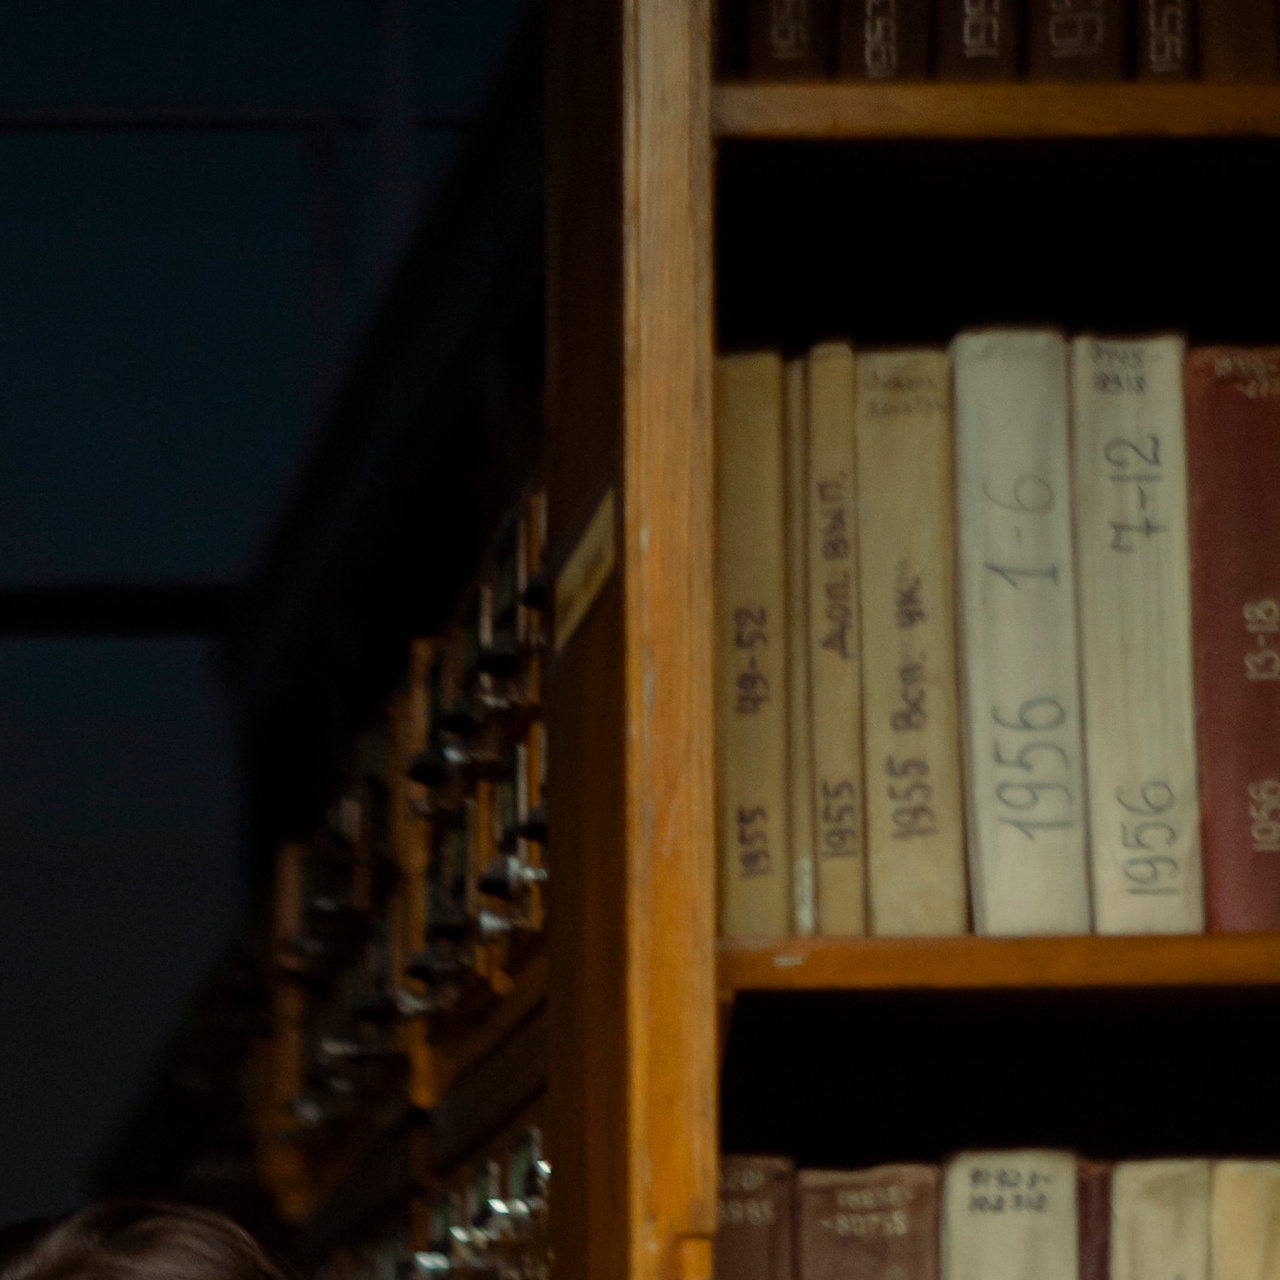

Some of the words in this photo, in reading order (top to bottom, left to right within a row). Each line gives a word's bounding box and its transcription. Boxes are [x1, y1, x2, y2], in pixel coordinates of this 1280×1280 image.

[982, 474, 1060, 590] 1-6
[1103, 434, 1166, 554] 7-12
[733, 606, 770, 717] 49-52
[820, 779, 858, 860] 1955
[884, 755, 938, 841] 1955
[992, 695, 1075, 842] 1956
[1246, 778, 1280, 853] 1956
[736, 804, 773, 879] 1955
[1114, 779, 1181, 898] 1956
